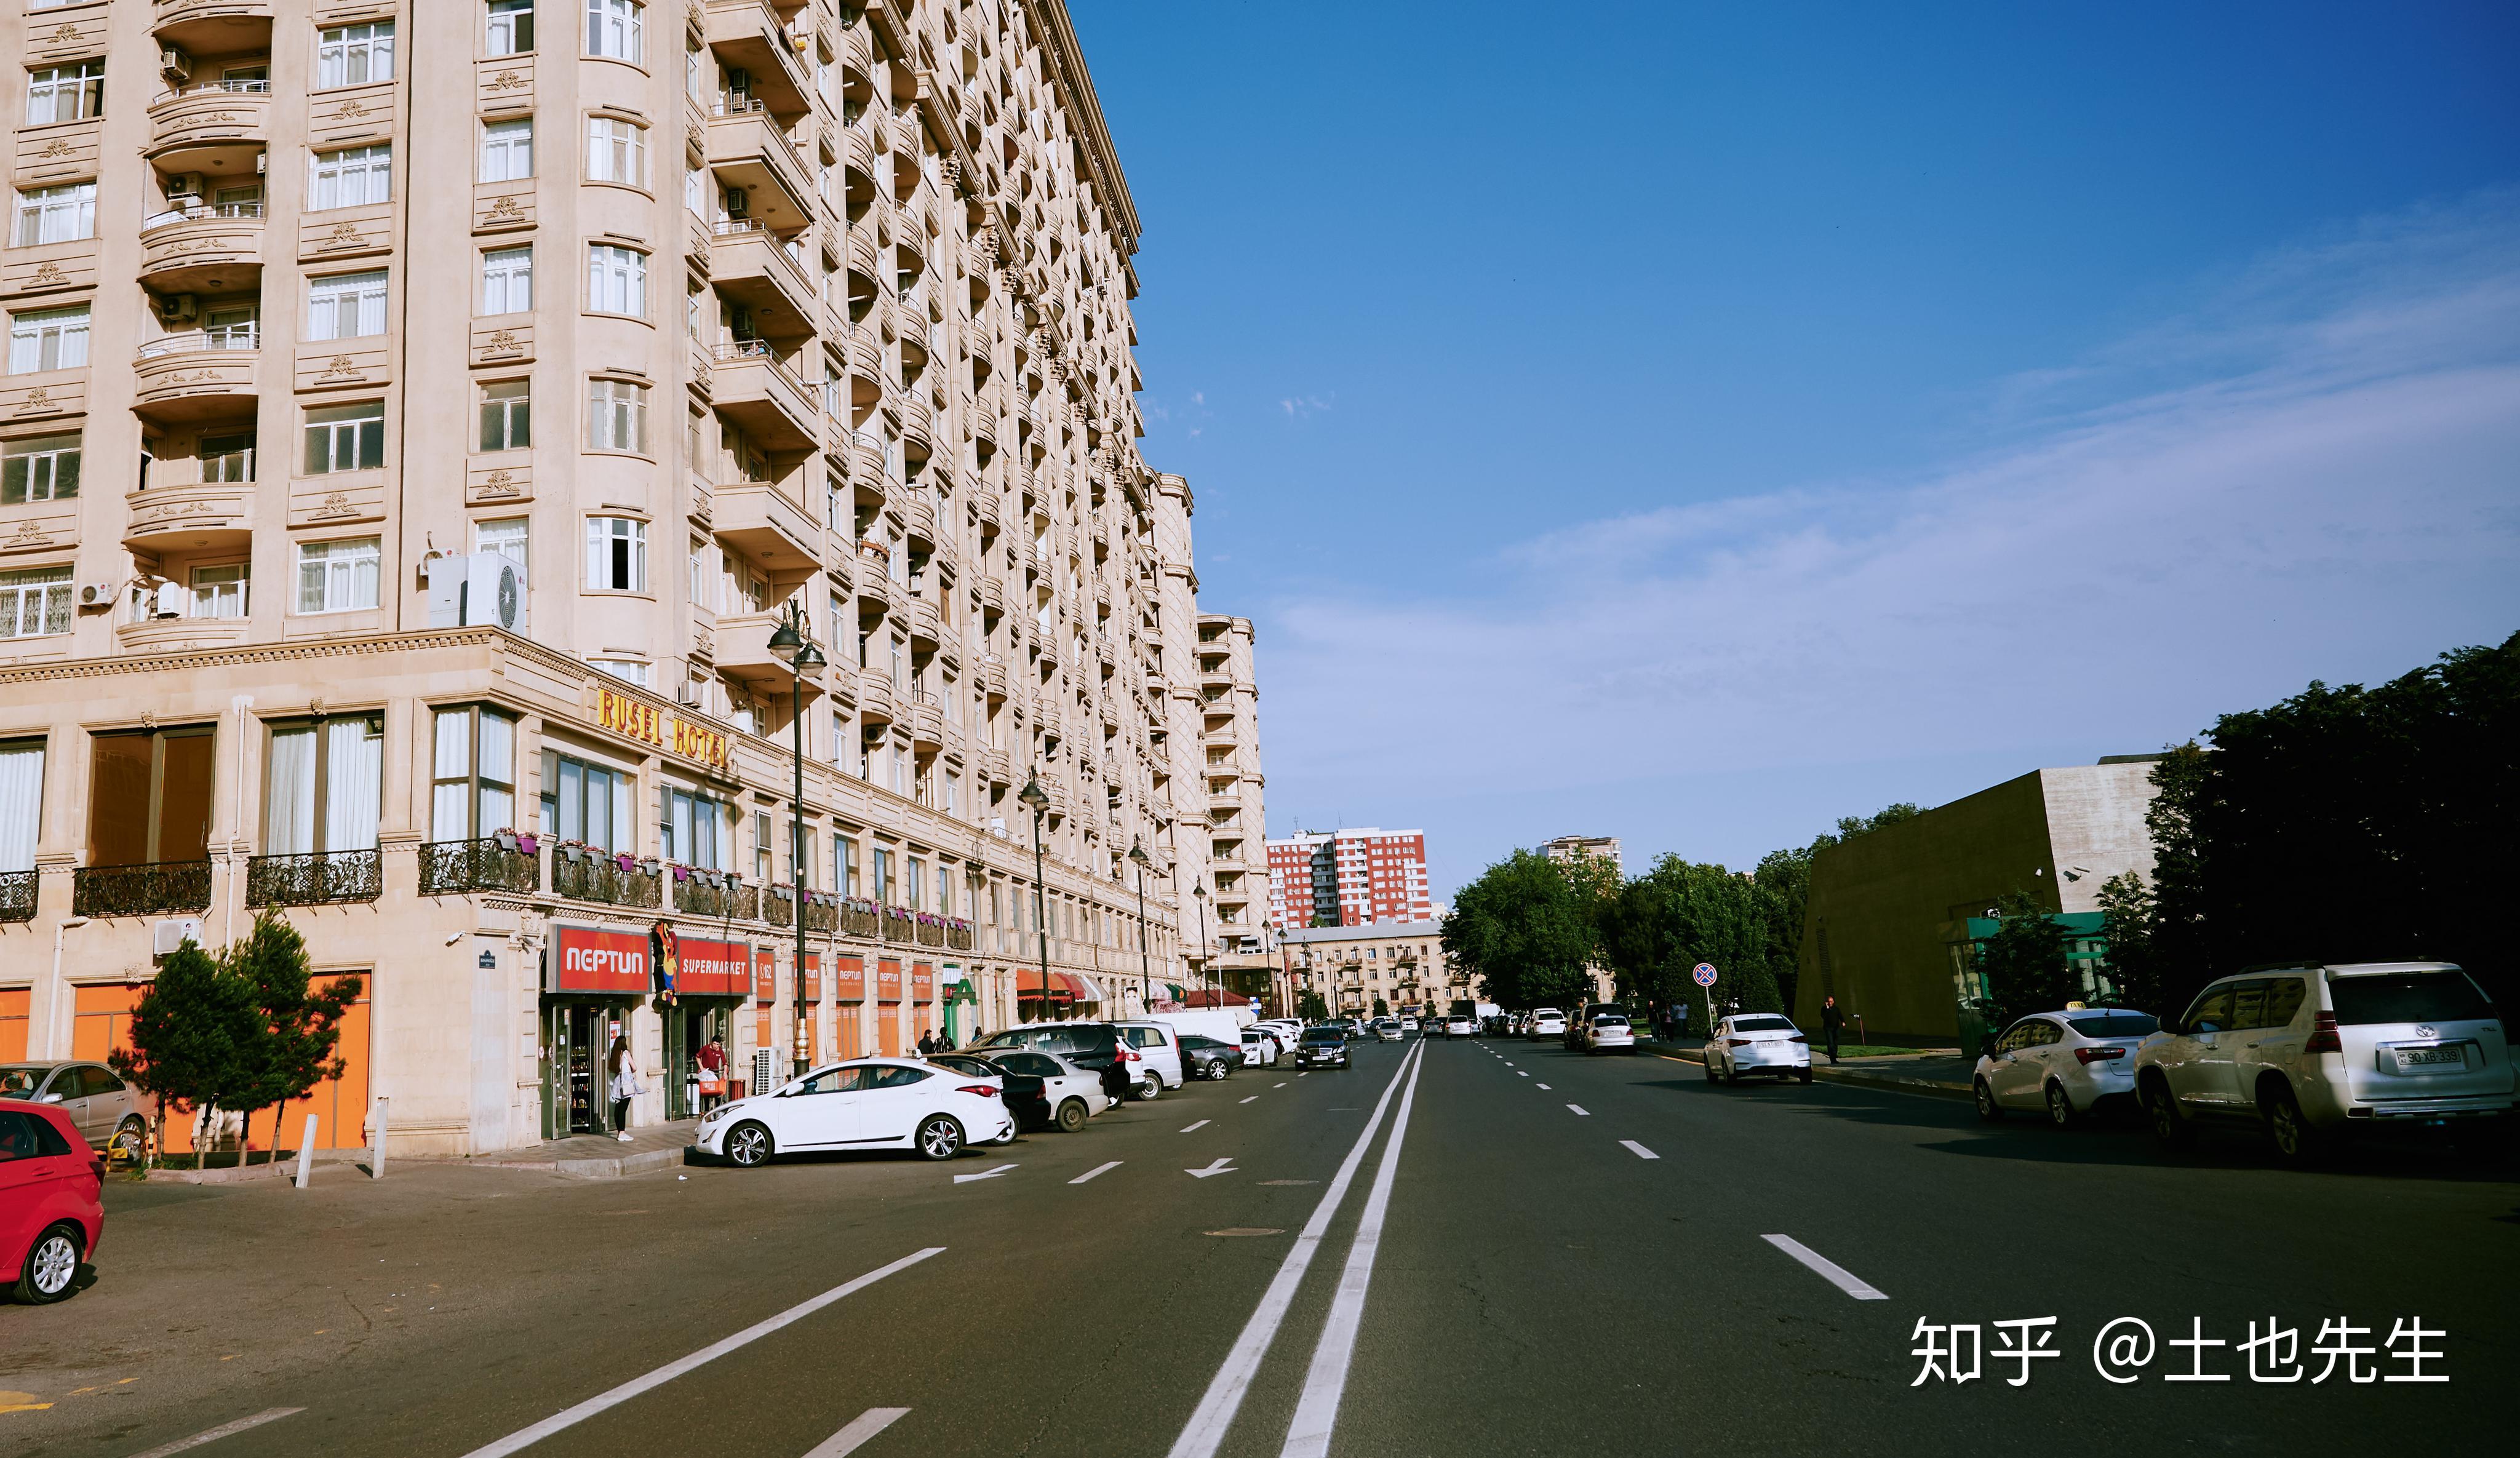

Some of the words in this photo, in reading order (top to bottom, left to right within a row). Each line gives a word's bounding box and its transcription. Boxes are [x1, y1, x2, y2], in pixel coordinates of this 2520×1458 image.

[599, 689, 663, 747] RUSEL
[673, 718, 728, 769] HOTEL
[566, 947, 644, 974] NEPTUN
[683, 958, 746, 976] SUPERMARKET
[840, 970, 861, 980] NEPTUN
[880, 972, 899, 982] NEPTUN
[2407, 1051, 2457, 1062] 90-XB-339
